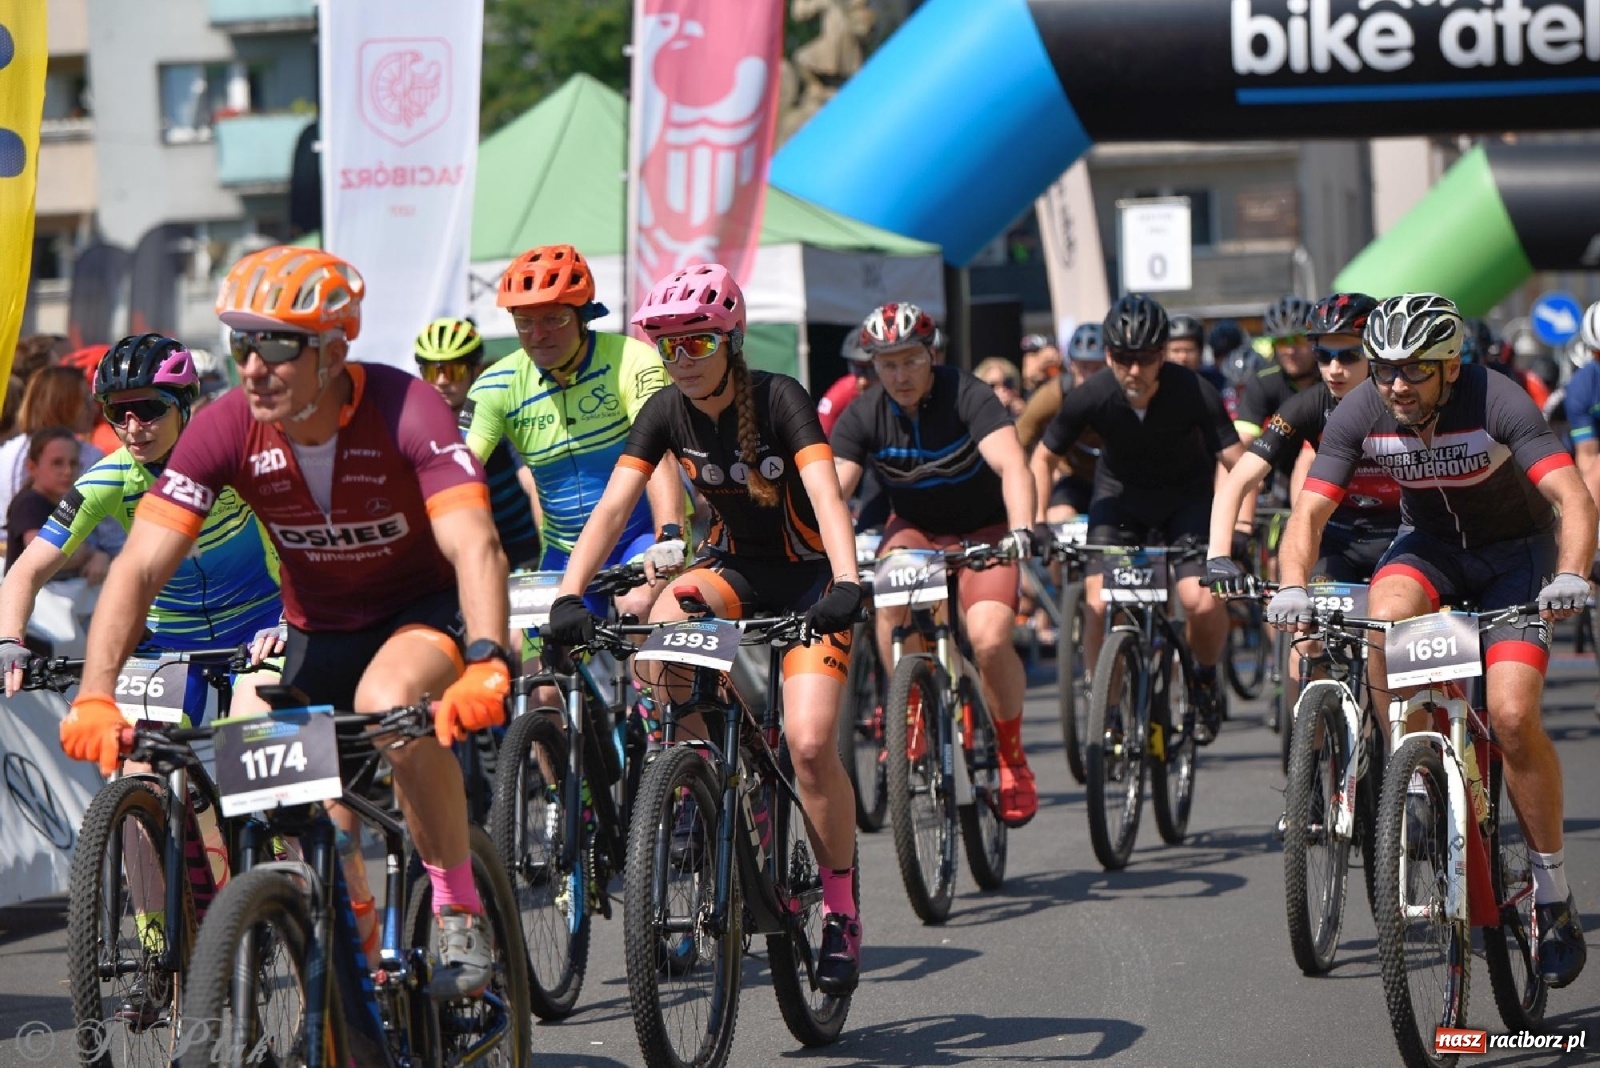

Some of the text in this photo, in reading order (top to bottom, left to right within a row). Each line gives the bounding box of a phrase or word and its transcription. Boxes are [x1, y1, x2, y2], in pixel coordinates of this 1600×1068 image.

[1230, 0, 1415, 75] bike
[279, 520, 402, 547] OSHEE
[662, 632, 719, 651] 1393
[1406, 635, 1457, 662] 1691
[241, 741, 308, 781] 1174
